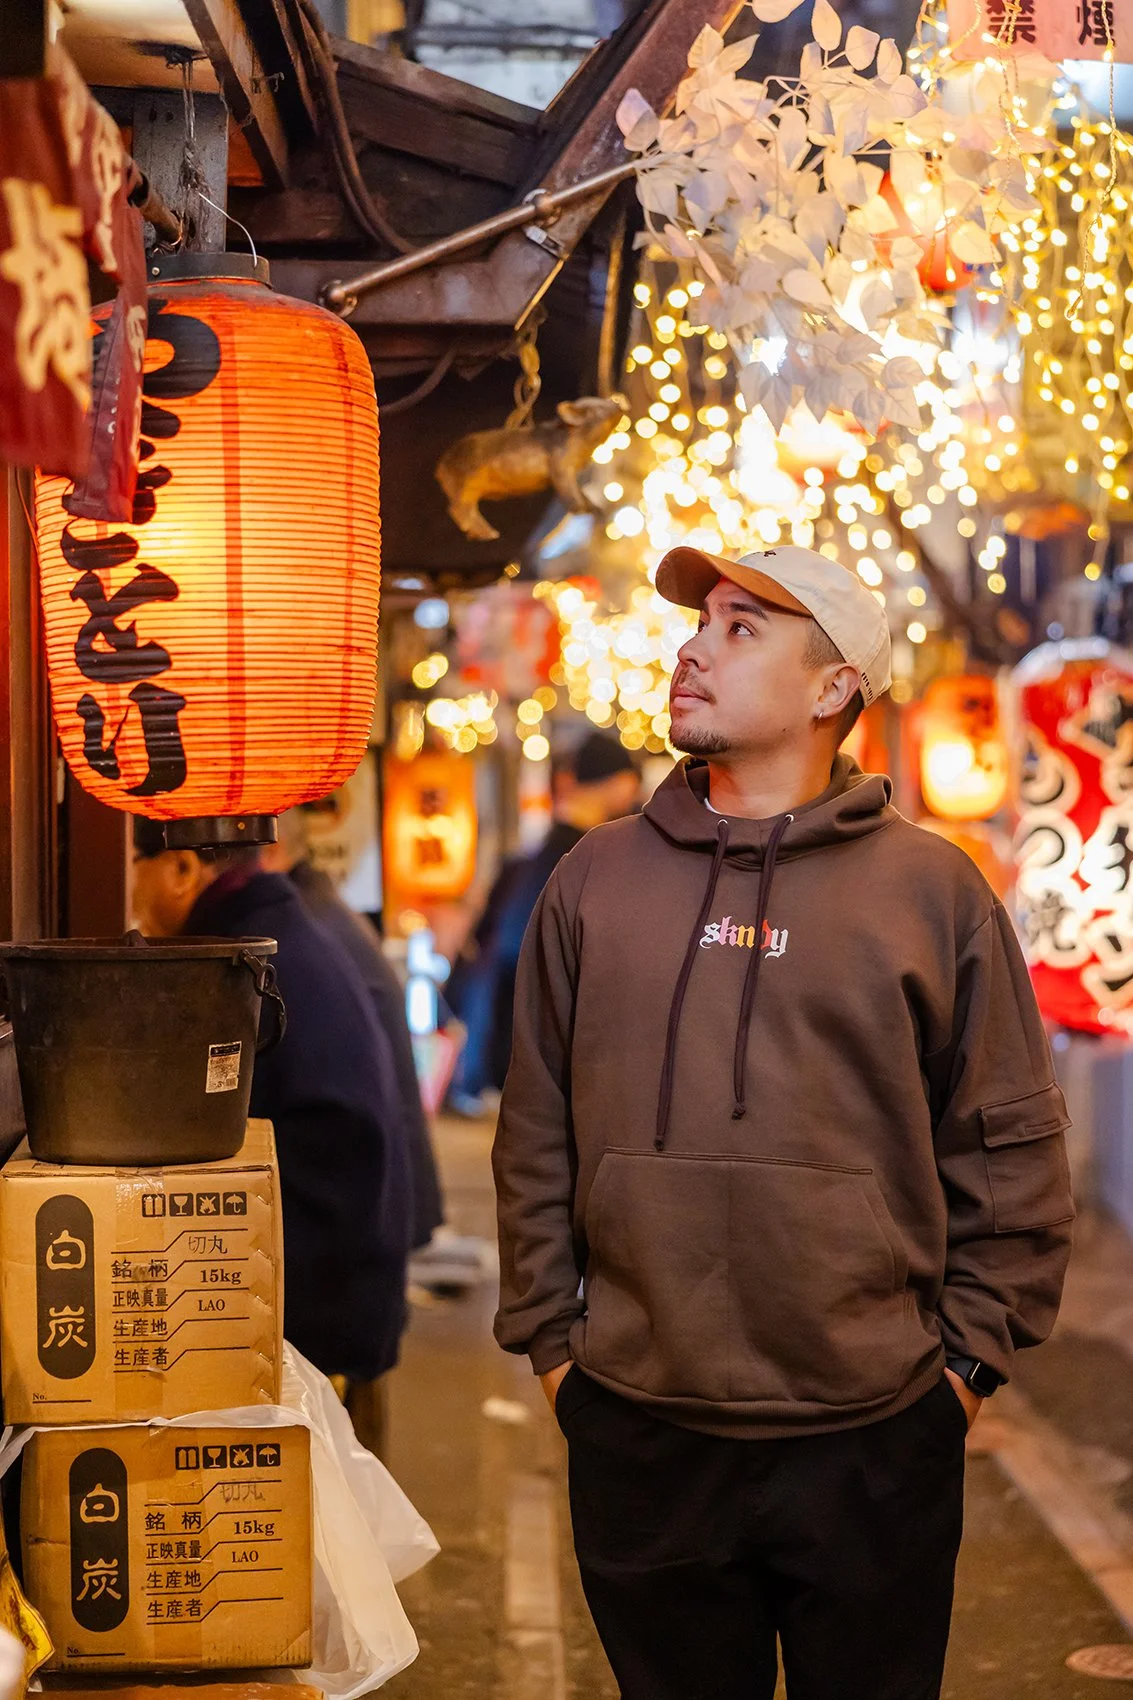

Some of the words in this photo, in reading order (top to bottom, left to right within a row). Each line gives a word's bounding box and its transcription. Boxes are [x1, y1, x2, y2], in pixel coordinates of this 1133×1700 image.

[188, 1235, 228, 1254] 切丸
[200, 1268, 242, 1285] 15kg
[43, 1229, 88, 1349] 白炭
[198, 1298, 226, 1312] LAO
[113, 1318, 168, 1337] 生産地
[114, 1347, 169, 1366] 生産者
[32, 1392, 47, 1400] No.
[234, 1520, 275, 1536] 15kg
[76, 1483, 122, 1601] 白炭
[231, 1550, 259, 1564] LAO
[146, 1570, 202, 1589] 生産地
[147, 1598, 203, 1618] 生産者
[66, 1647, 81, 1655] No.
